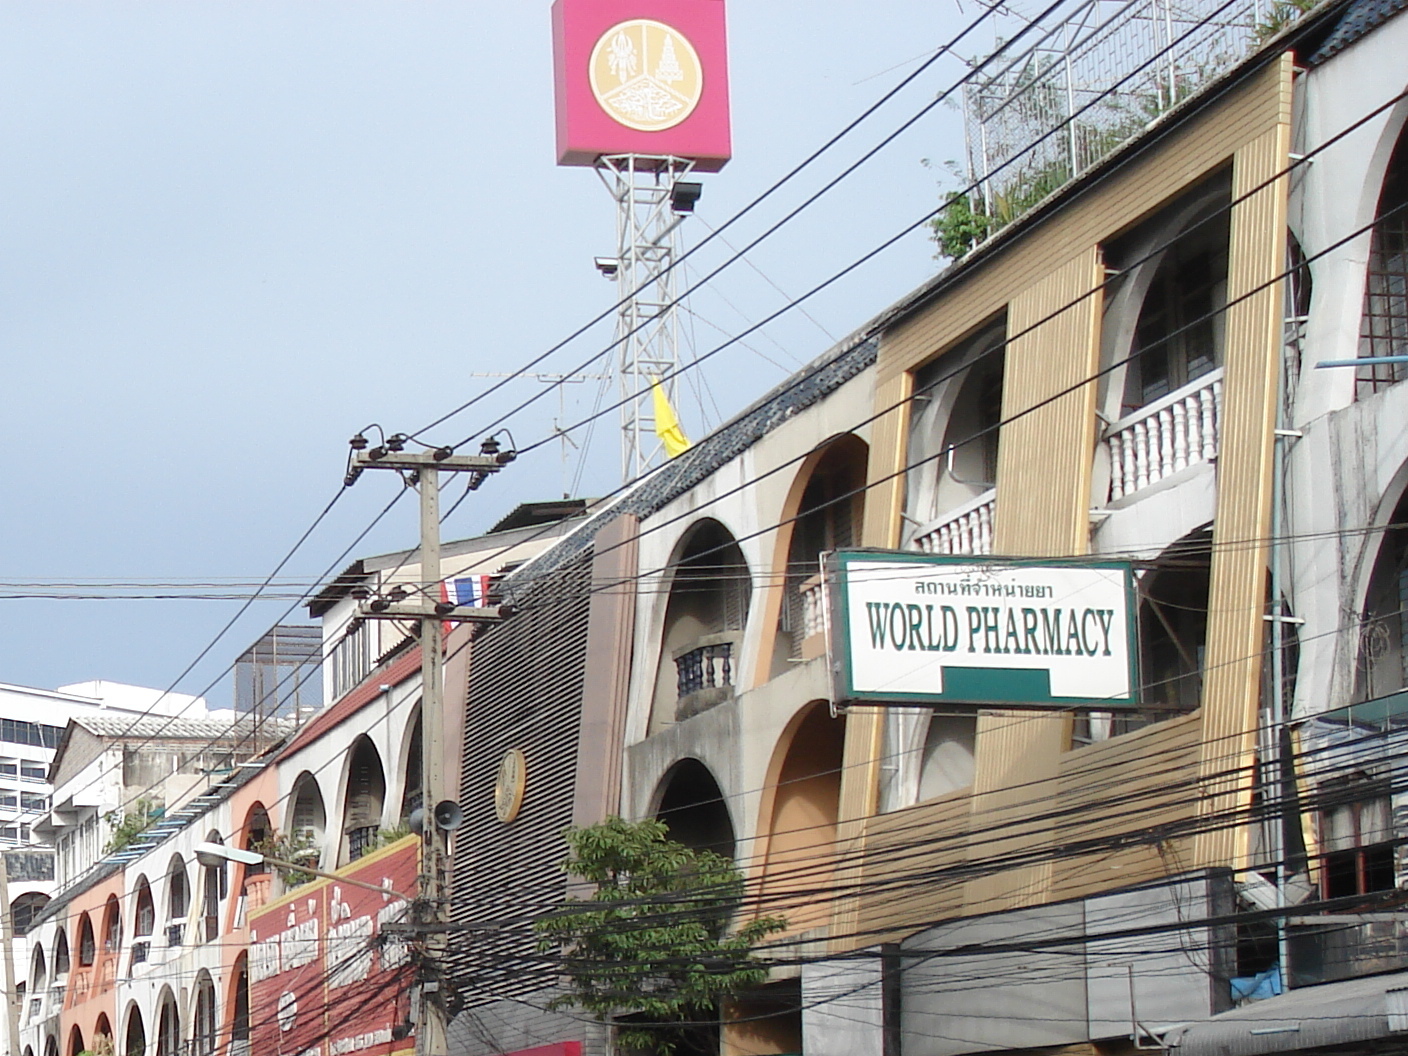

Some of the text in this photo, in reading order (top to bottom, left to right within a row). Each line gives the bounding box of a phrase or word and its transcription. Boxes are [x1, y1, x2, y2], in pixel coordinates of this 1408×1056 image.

[914, 574, 1054, 599] สถานที่จำหน่ายยา
[866, 602, 1114, 657] WORLD PHARMACY
